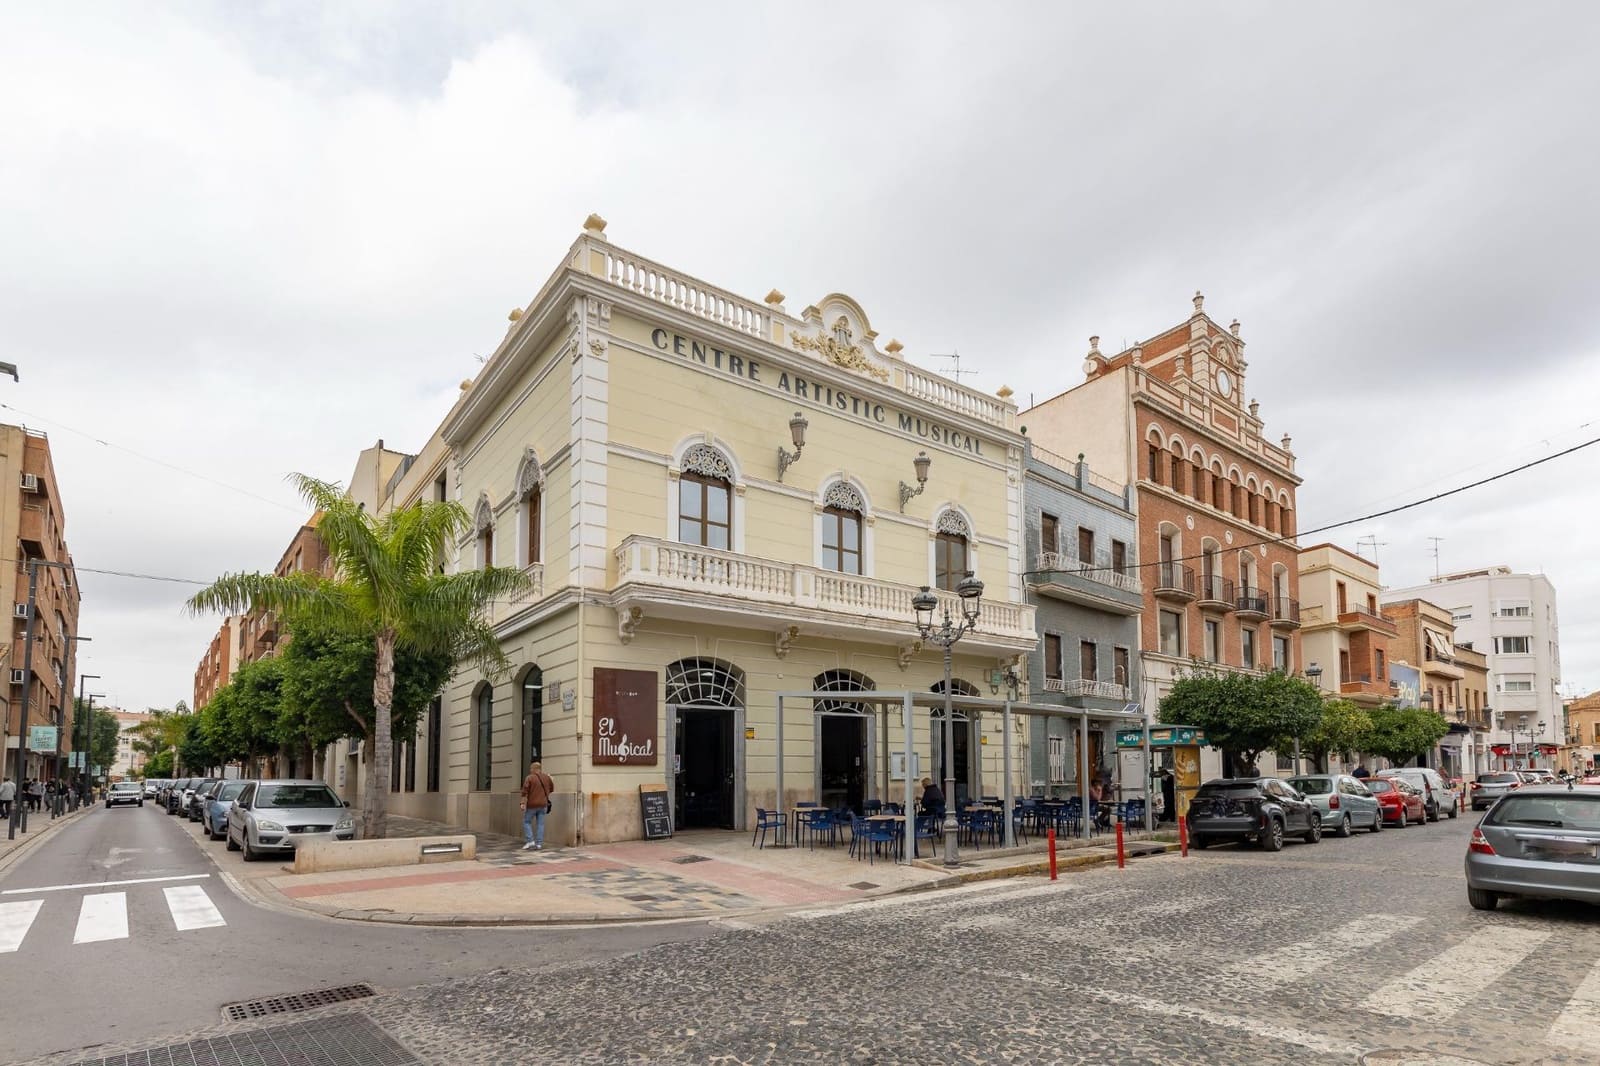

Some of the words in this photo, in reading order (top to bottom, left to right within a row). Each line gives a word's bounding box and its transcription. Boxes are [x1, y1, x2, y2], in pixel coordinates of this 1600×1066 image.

[652, 328, 760, 381] CENTRE
[777, 372, 886, 422] ARTISTIC
[897, 413, 984, 455] MUSICAL
[598, 718, 616, 736] El
